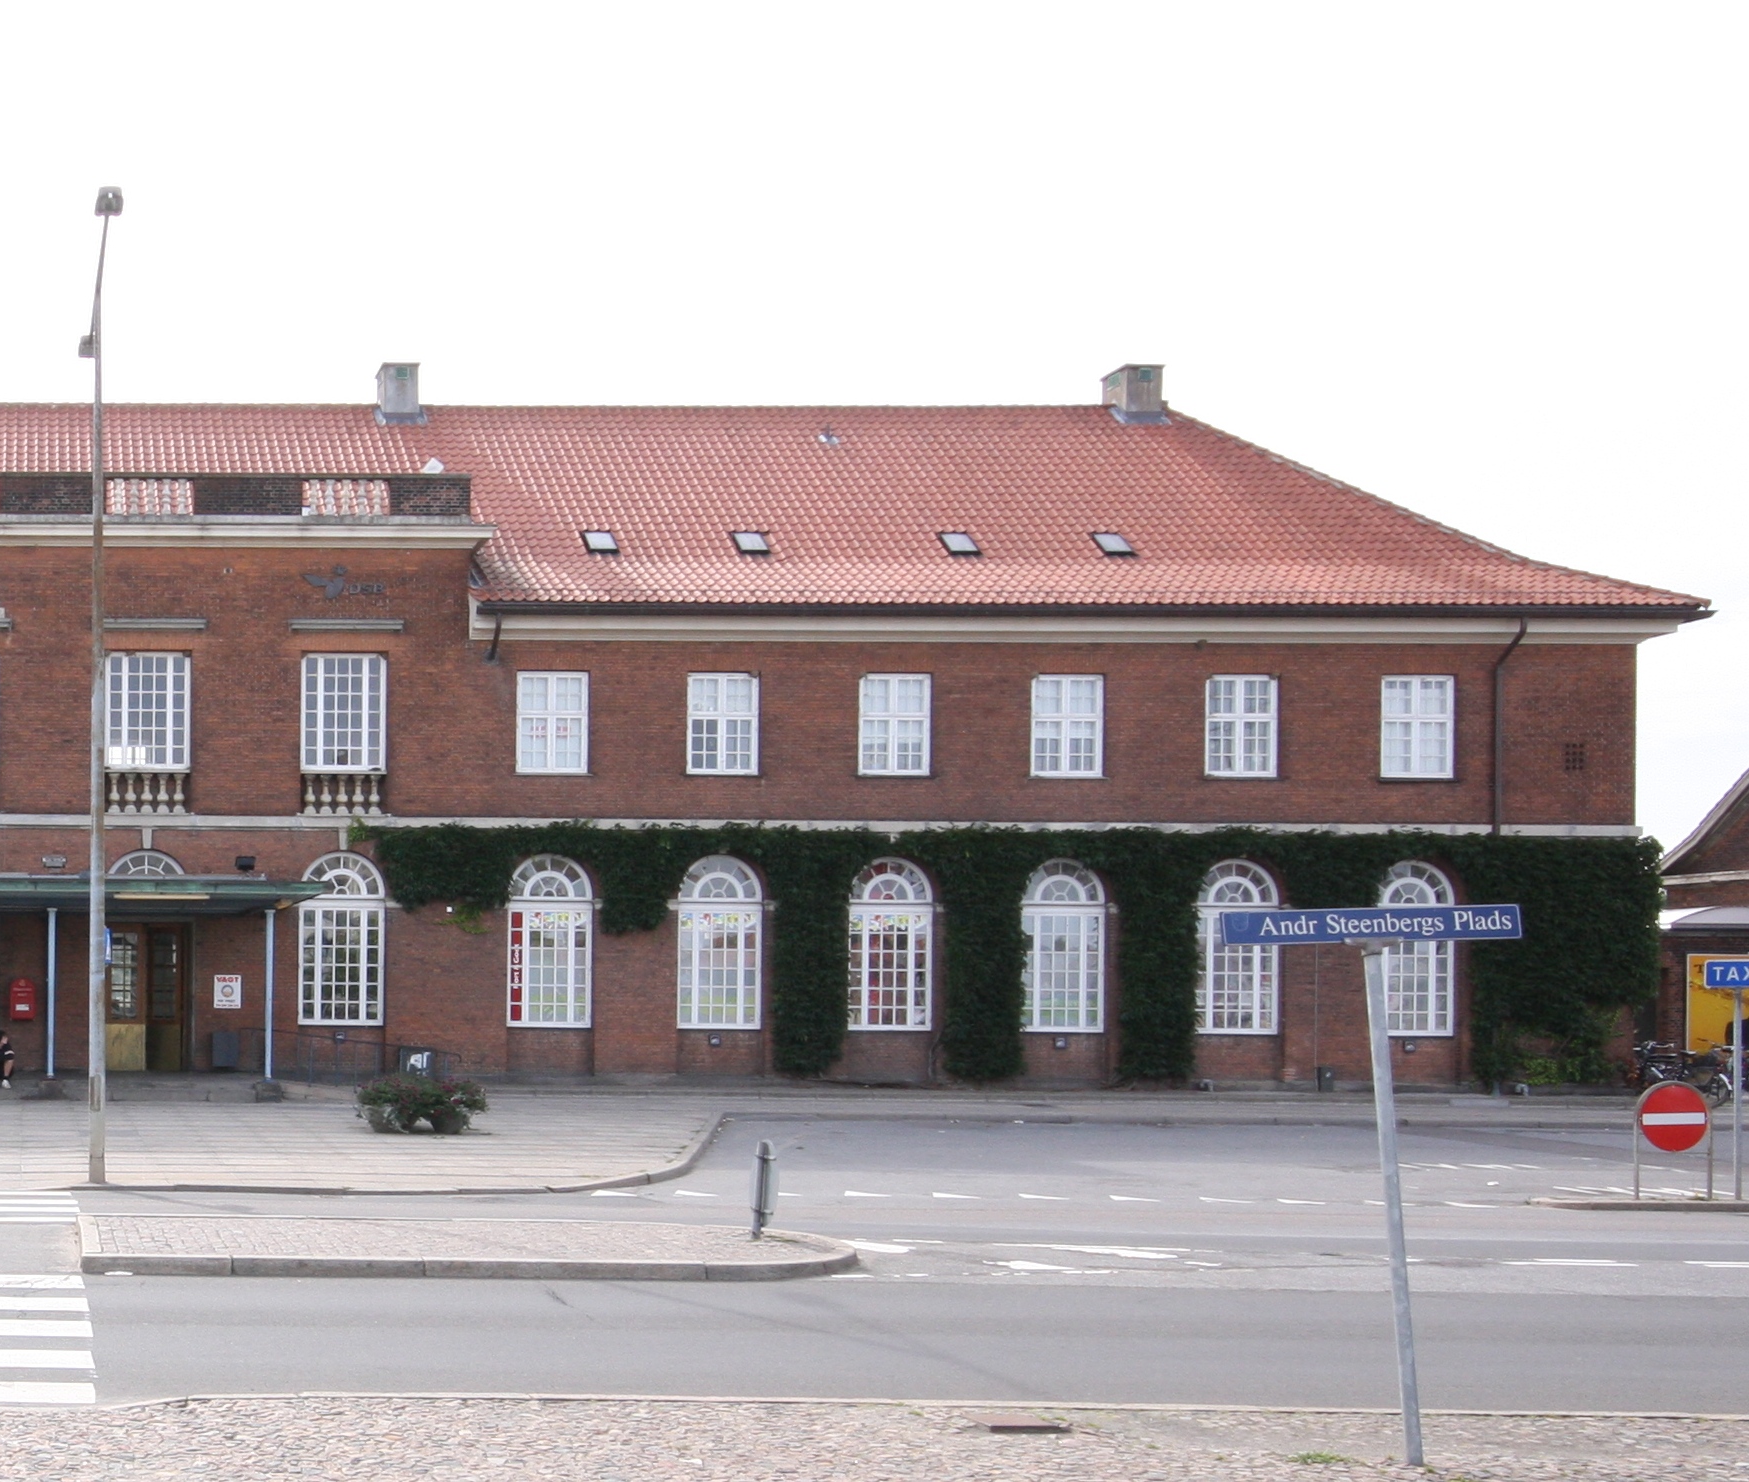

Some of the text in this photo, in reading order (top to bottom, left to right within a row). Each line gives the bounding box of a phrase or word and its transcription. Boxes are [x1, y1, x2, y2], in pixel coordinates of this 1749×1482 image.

[1259, 909, 1512, 936] Andr Steenbergs Plads
